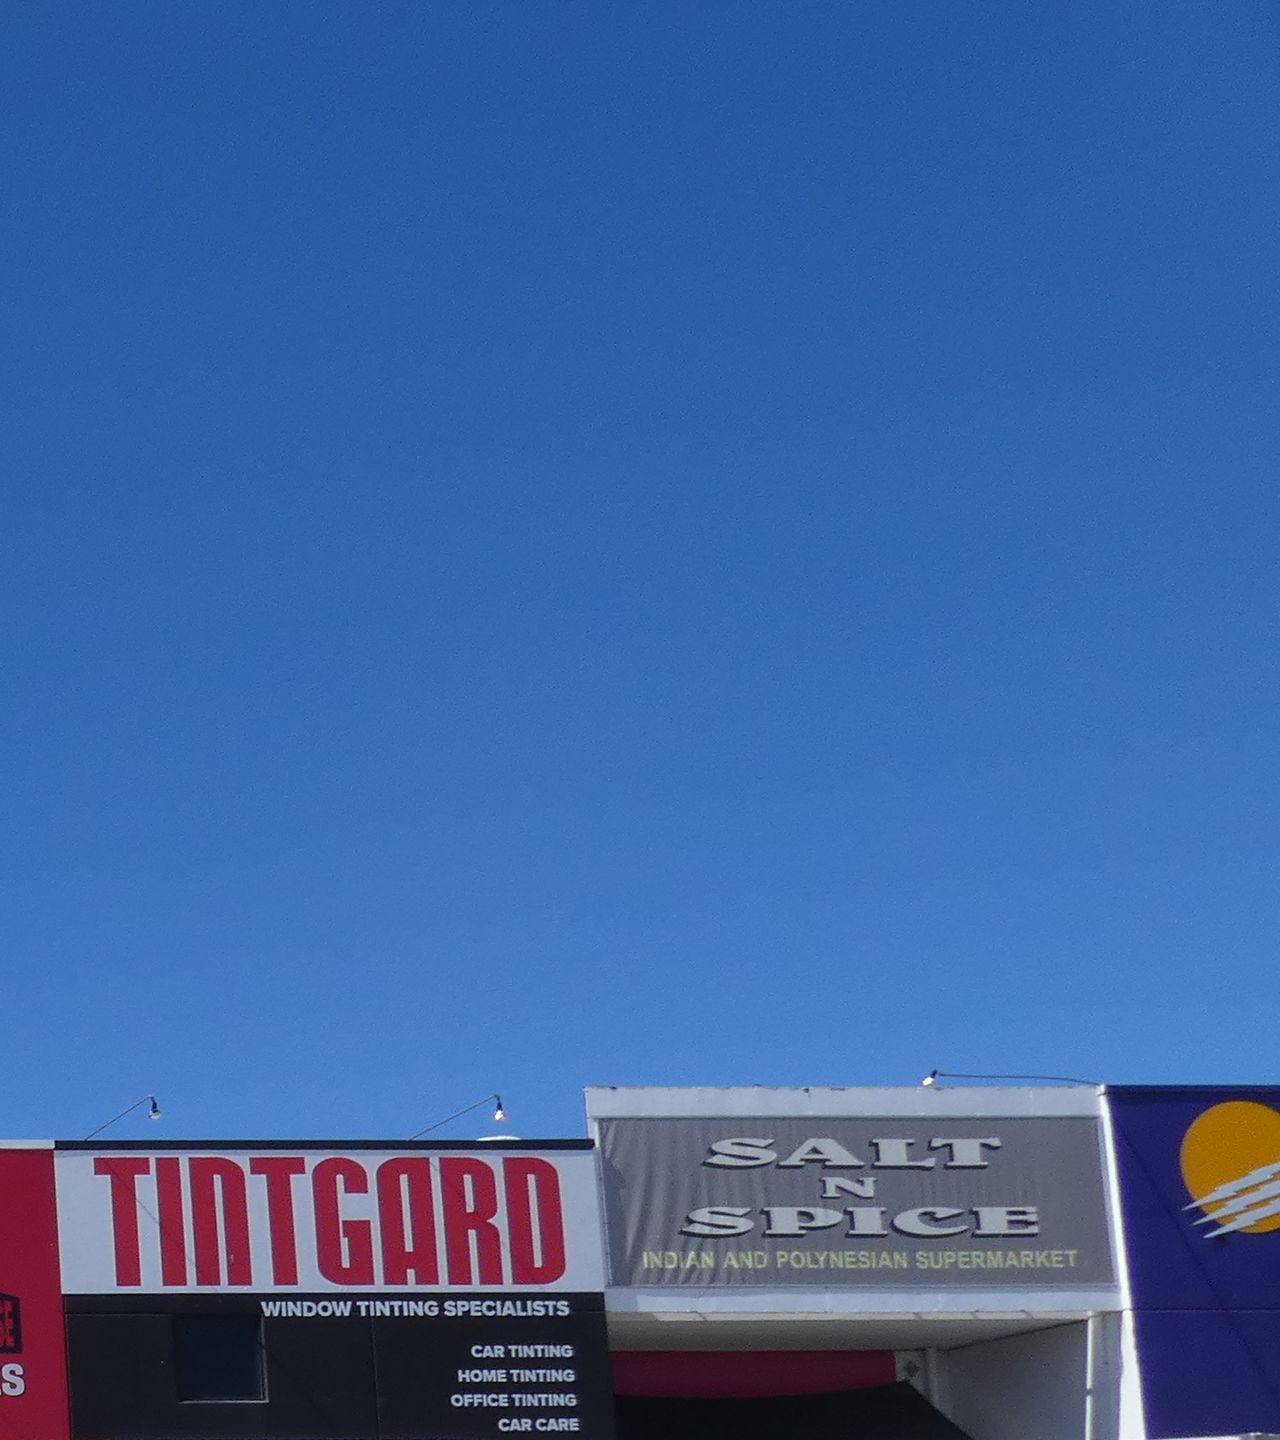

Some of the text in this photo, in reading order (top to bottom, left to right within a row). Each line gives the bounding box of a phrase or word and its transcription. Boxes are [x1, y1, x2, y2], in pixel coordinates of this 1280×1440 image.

[705, 1137, 1001, 1170] SALT
[820, 1176, 877, 1200] N
[94, 1157, 565, 1286] TINTGARD
[682, 1205, 1039, 1239] SPICE
[643, 1250, 1078, 1269] INDIAN AND POLYNESIAN SUPERMARKET
[261, 1300, 570, 1318] WINDOW TINTING SPECIALISTS
[471, 1344, 573, 1359] CAR TINTING
[457, 1369, 575, 1384] HOME TINTING
[450, 1393, 577, 1408] OFFICE TINTING
[498, 1417, 580, 1432] CAR CARE
